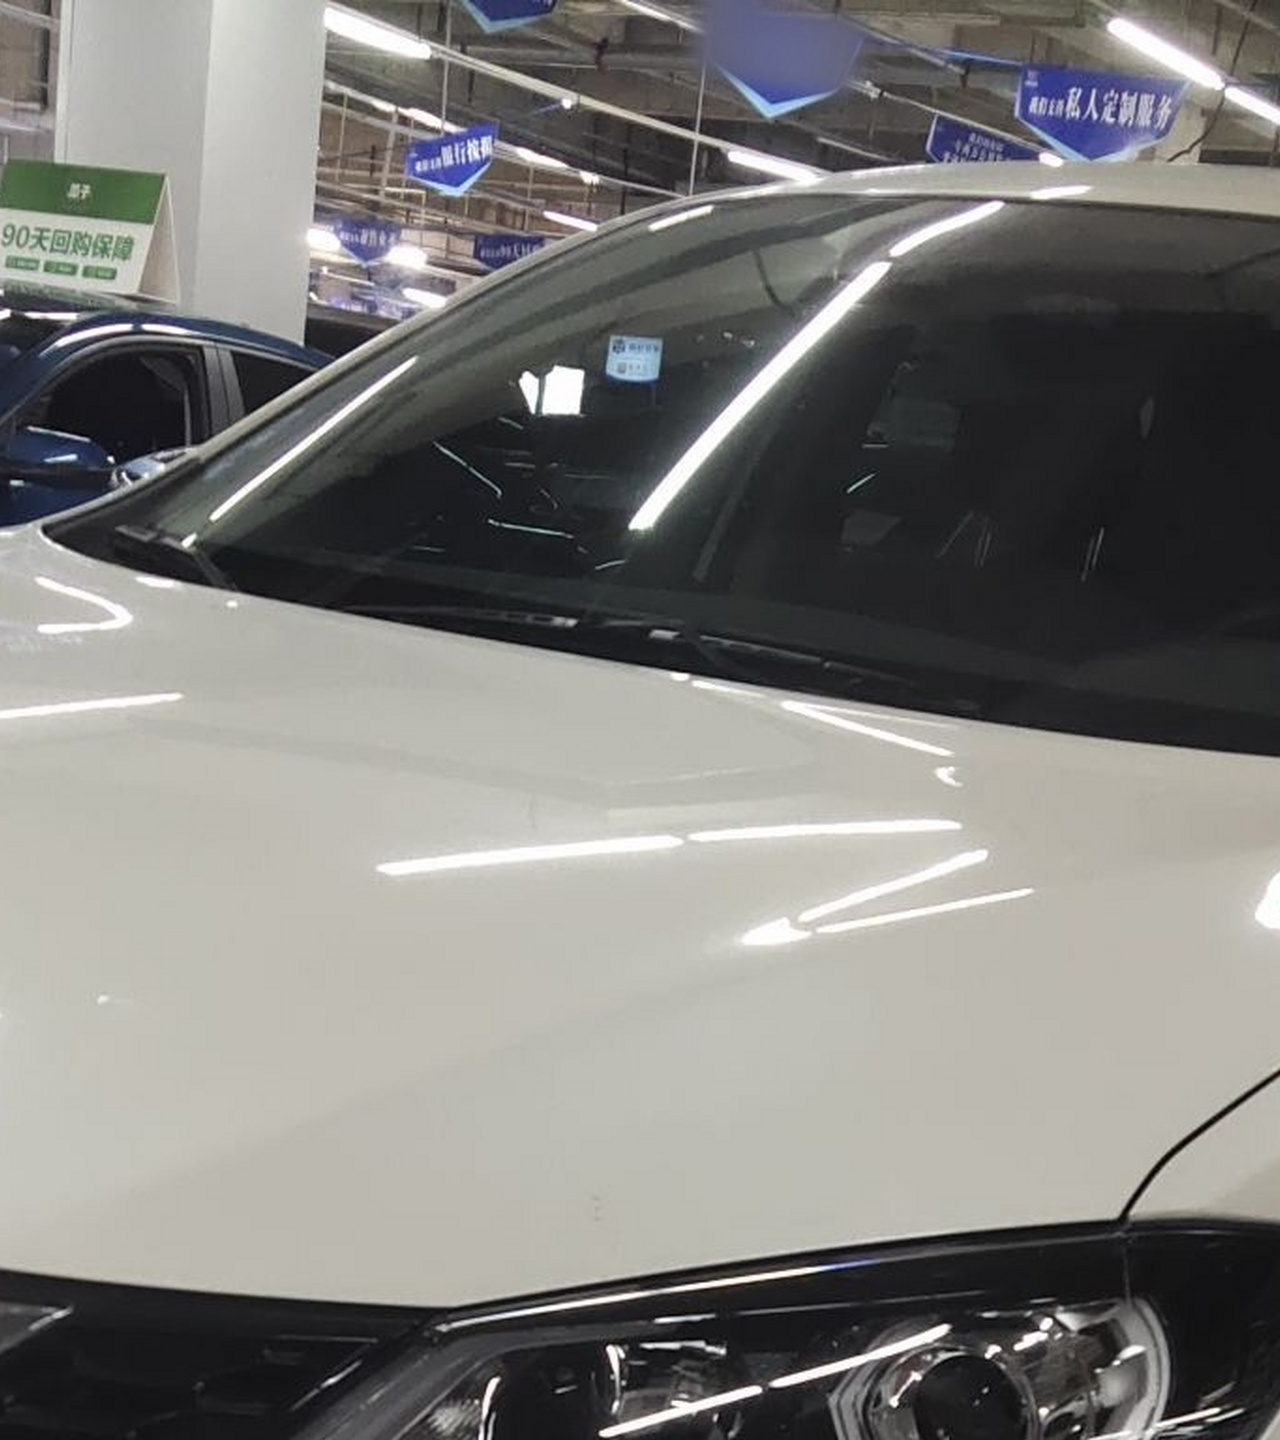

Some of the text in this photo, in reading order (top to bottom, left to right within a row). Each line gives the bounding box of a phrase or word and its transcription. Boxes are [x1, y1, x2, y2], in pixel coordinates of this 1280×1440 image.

[1, 223, 135, 262] 90天回购保障
